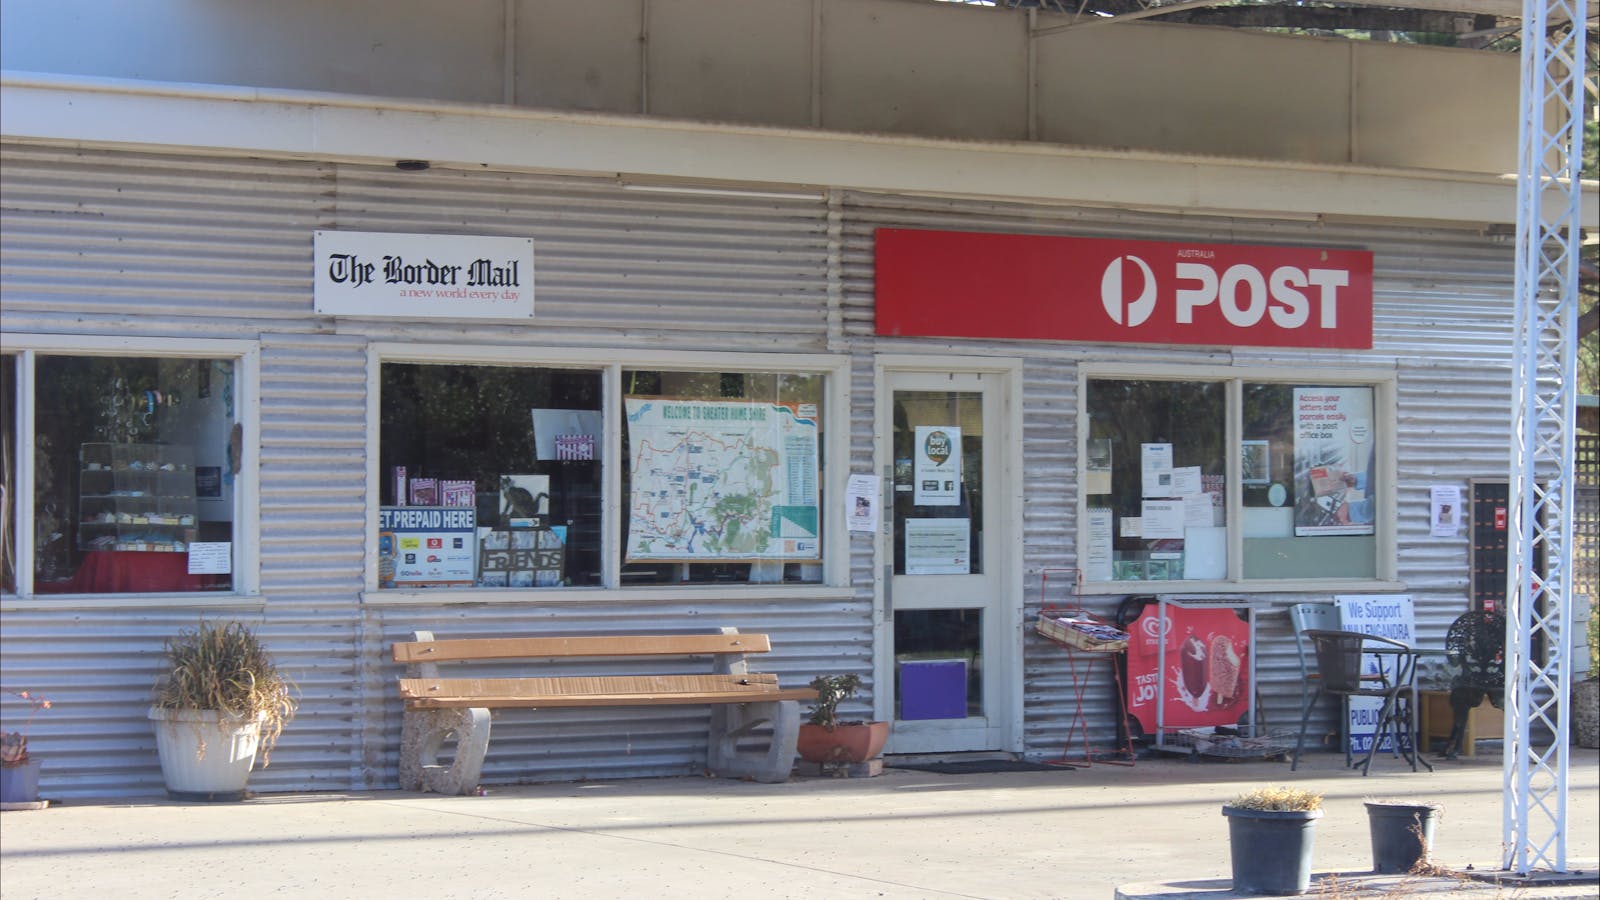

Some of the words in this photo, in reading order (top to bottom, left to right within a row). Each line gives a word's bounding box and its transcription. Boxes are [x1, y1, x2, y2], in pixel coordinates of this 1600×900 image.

[1177, 249, 1215, 259] AUSTRALIA
[329, 253, 375, 288] The
[382, 255, 462, 284] Border
[467, 258, 520, 287] Mail
[408, 289, 432, 297] new
[435, 288, 467, 298] world
[469, 291, 499, 303] every
[501, 290, 520, 301] day
[1175, 262, 1349, 329] POST
[1325, 395, 1340, 403] your
[663, 405, 691, 419] WELCOME
[692, 406, 701, 419] TO
[703, 406, 729, 420] GREATER
[730, 407, 748, 420] HUME
[749, 407, 766, 421] SHIRE
[1327, 413, 1347, 421] easily
[1322, 423, 1338, 431] post
[930, 435, 946, 448] buy
[928, 445, 949, 455] local
[443, 511, 474, 529] HERE
[484, 551, 560, 571] FRIENDS
[1348, 602, 1363, 618] We
[1365, 602, 1402, 621] Support
